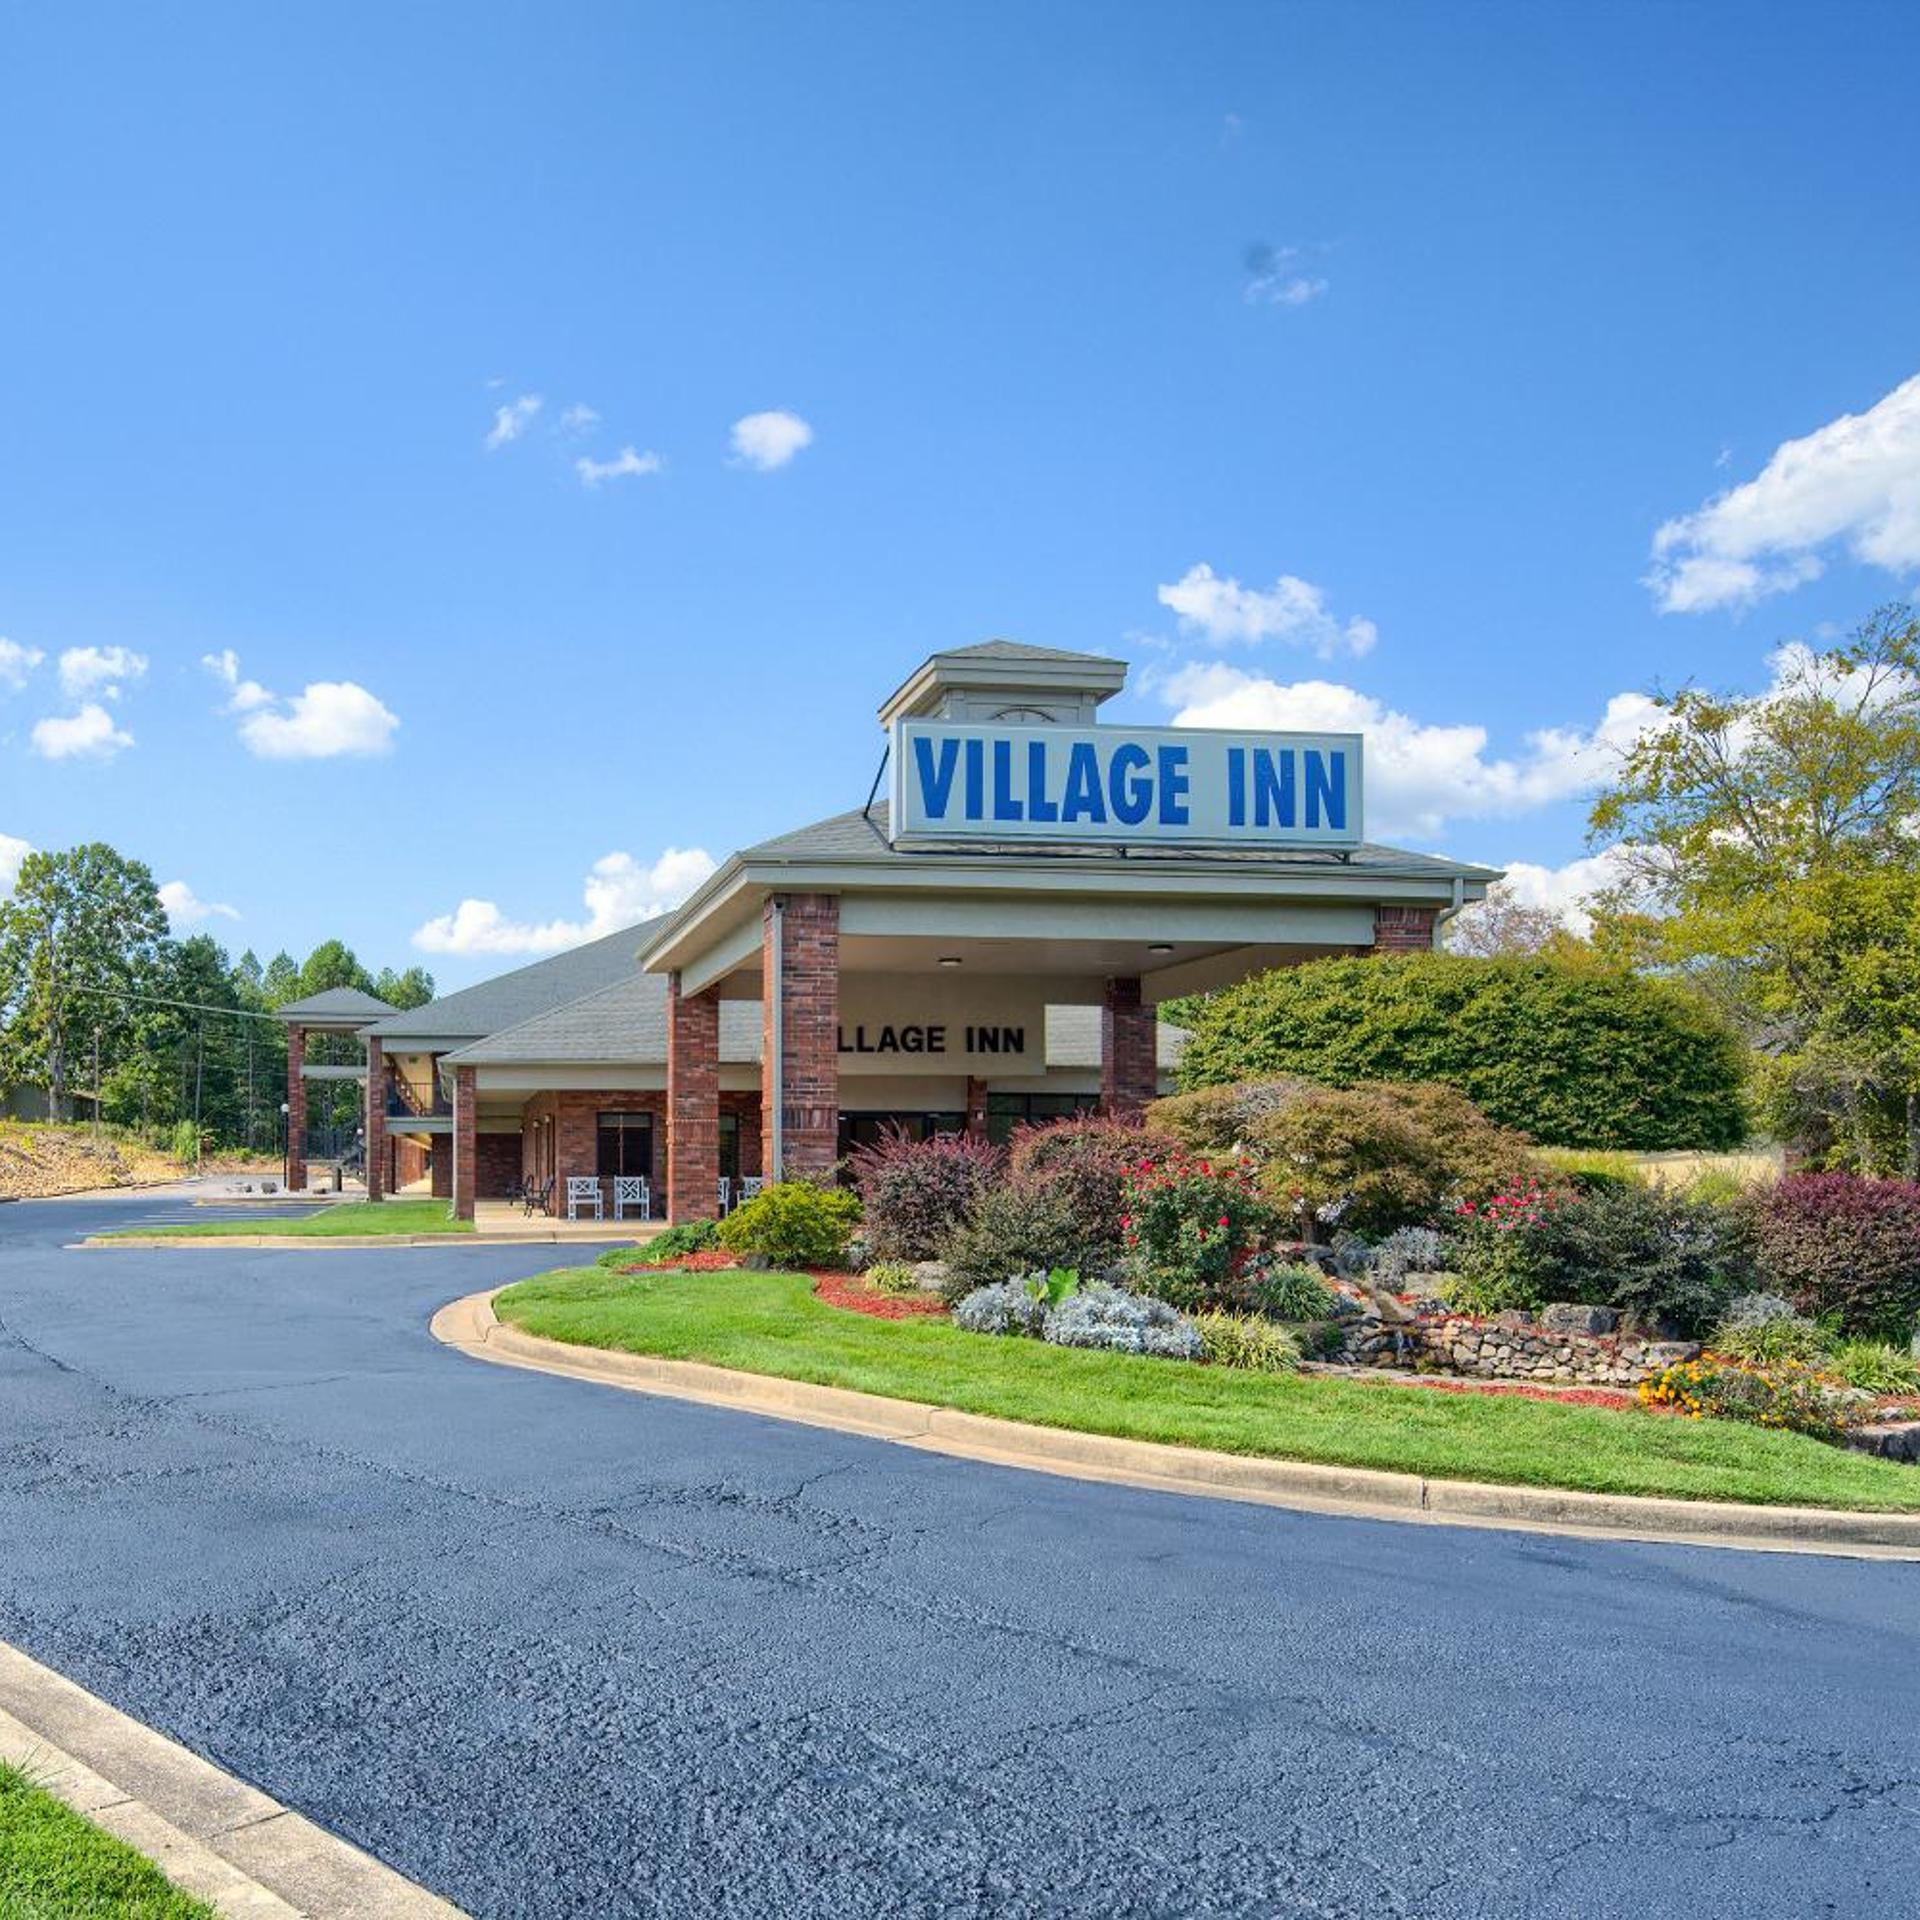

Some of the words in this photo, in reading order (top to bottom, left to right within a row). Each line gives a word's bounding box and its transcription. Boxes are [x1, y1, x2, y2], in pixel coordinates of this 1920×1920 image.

[912, 736, 1190, 826] VILLAGE
[1227, 747, 1347, 830] INN
[966, 1026, 1024, 1053] INN
